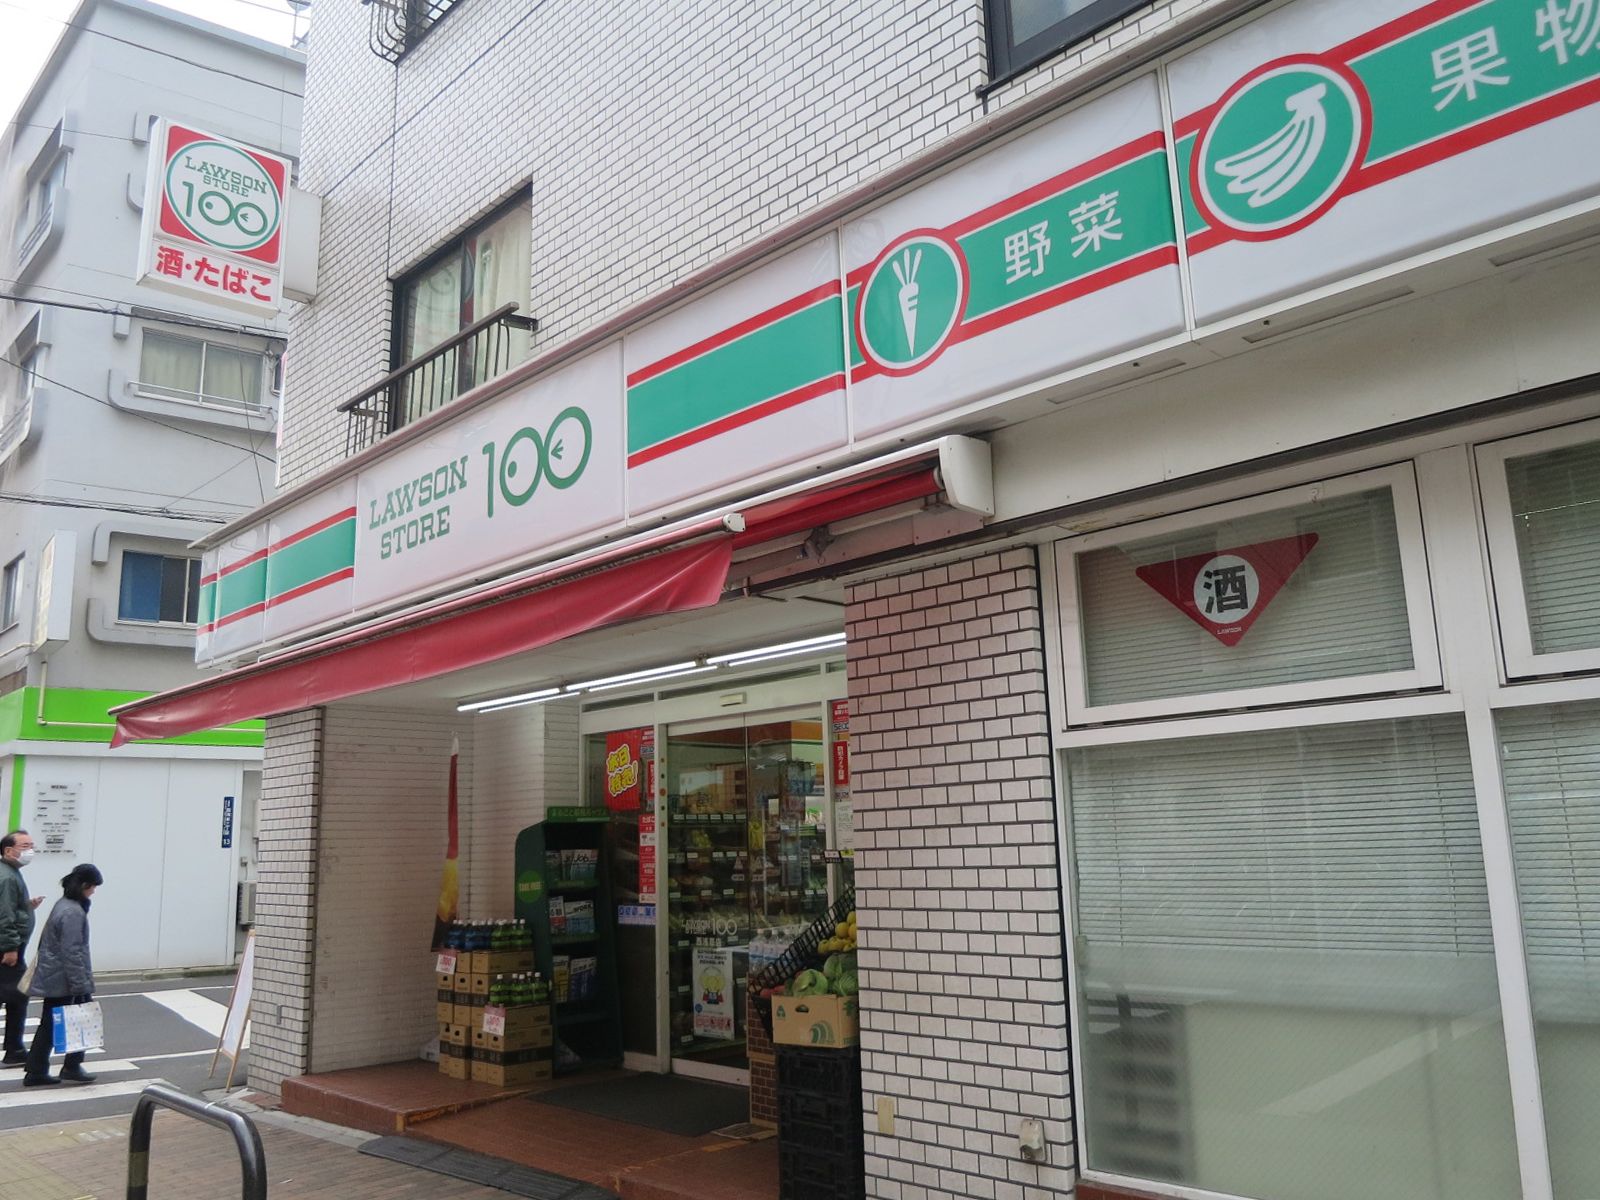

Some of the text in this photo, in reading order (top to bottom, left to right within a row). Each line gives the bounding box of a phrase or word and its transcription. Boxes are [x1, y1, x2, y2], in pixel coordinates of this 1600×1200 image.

[1431, 0, 1600, 112] 果物
[184, 156, 268, 194] LAWSON
[202, 175, 249, 197] STORE
[182, 181, 268, 236] 100
[1004, 190, 1123, 285] 野菜
[482, 406, 592, 519] 100
[369, 455, 469, 530] LAWSON
[380, 505, 450, 560] STORE
[1203, 565, 1249, 613] 酒
[712, 918, 738, 936] 100
